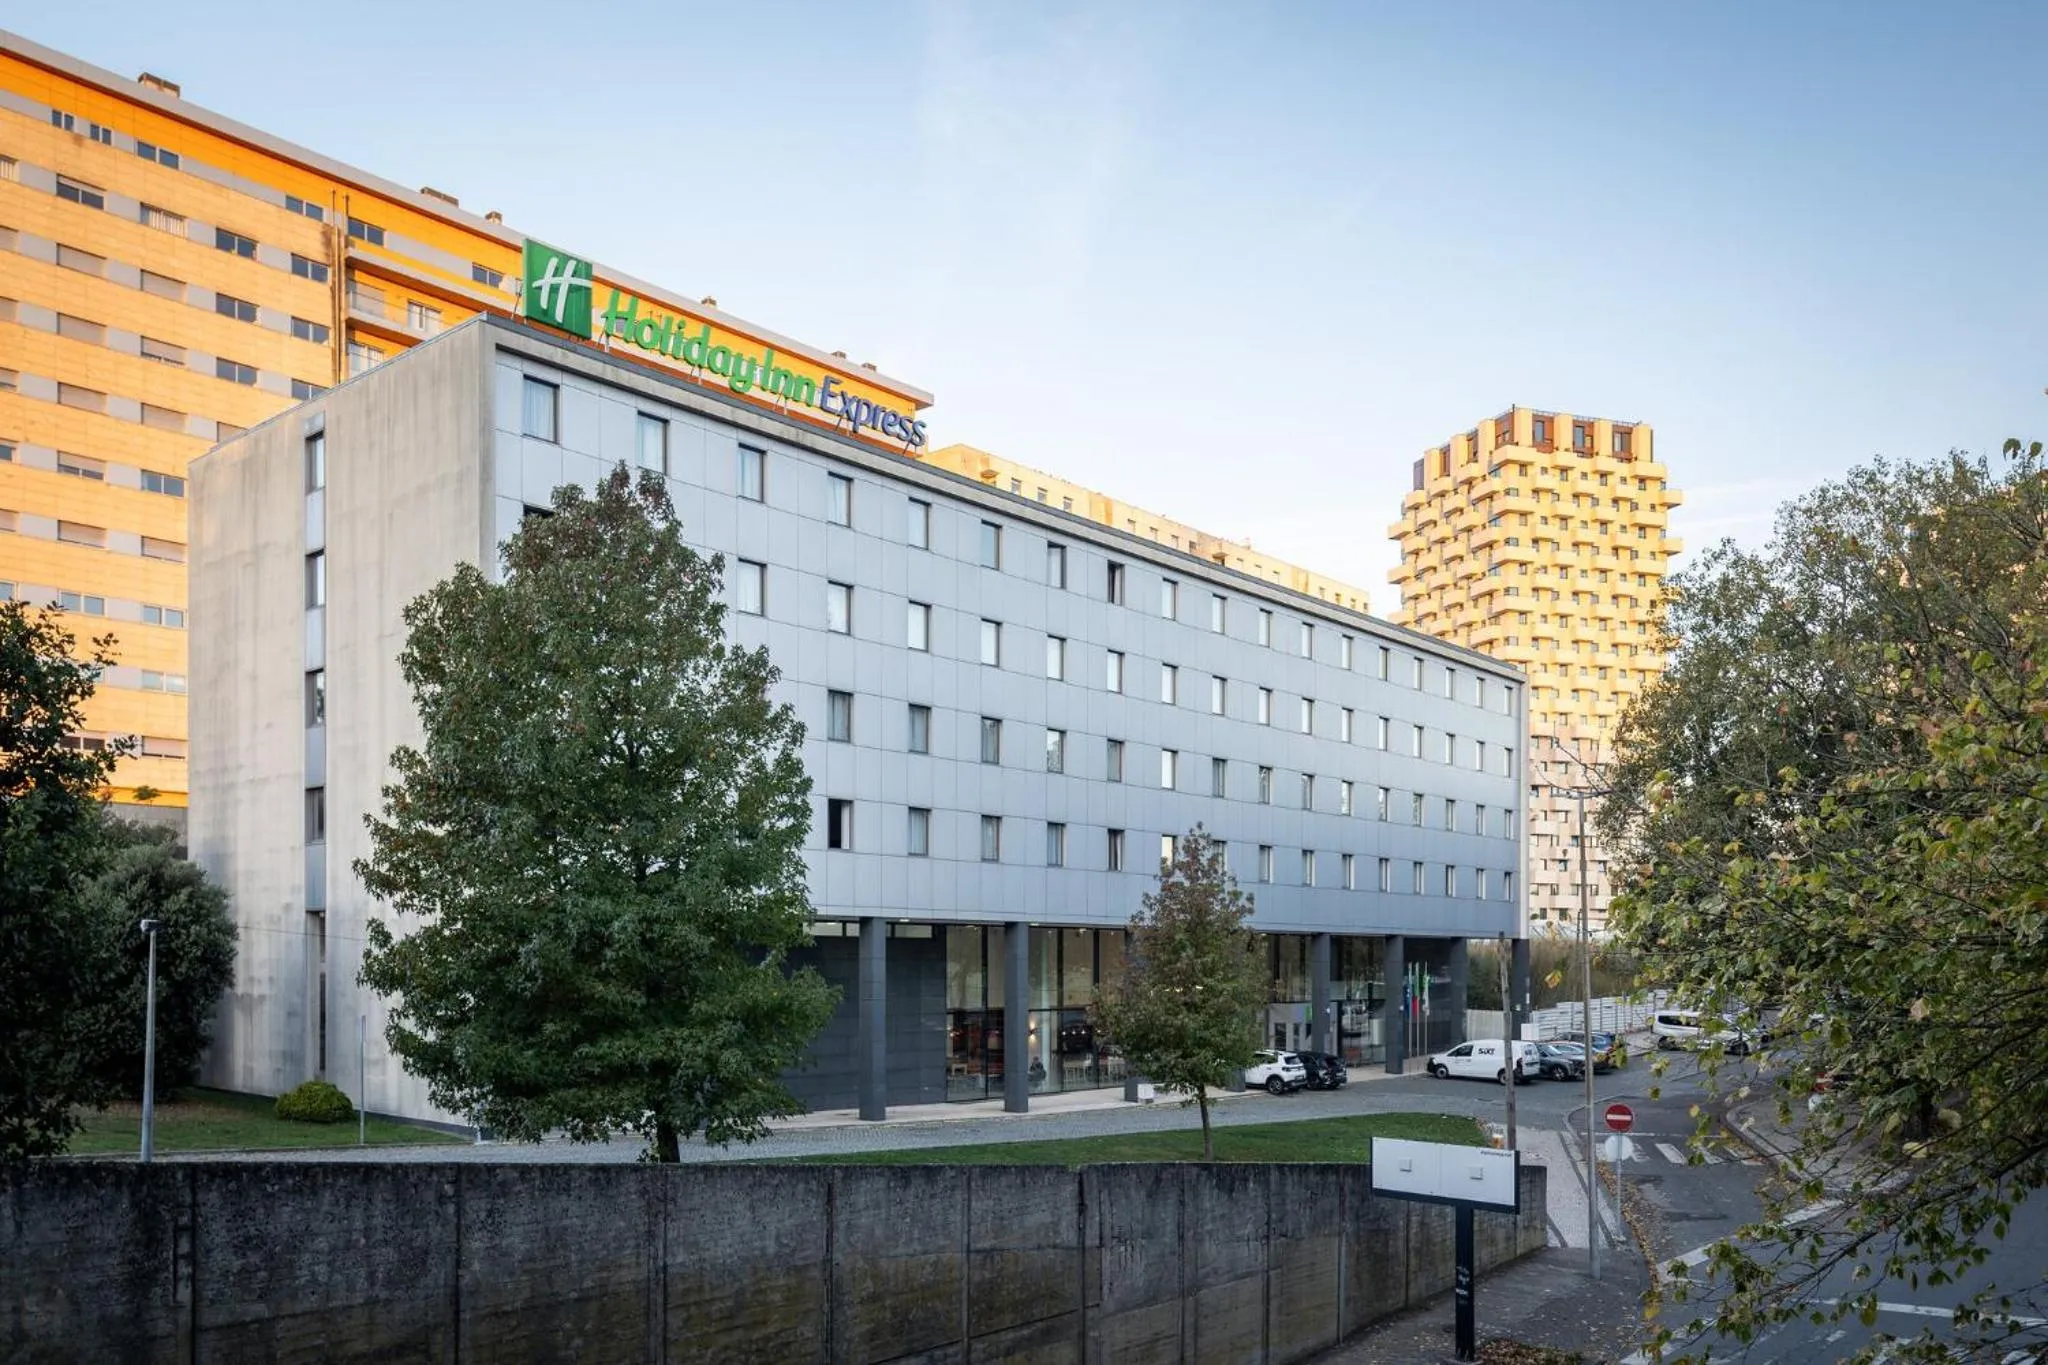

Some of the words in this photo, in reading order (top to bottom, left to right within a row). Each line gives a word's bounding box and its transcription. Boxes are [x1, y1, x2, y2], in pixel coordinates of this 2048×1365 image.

[532, 257, 592, 323] H
[601, 288, 757, 394] Holiday
[760, 348, 816, 407] Inn
[820, 375, 927, 447] Express
